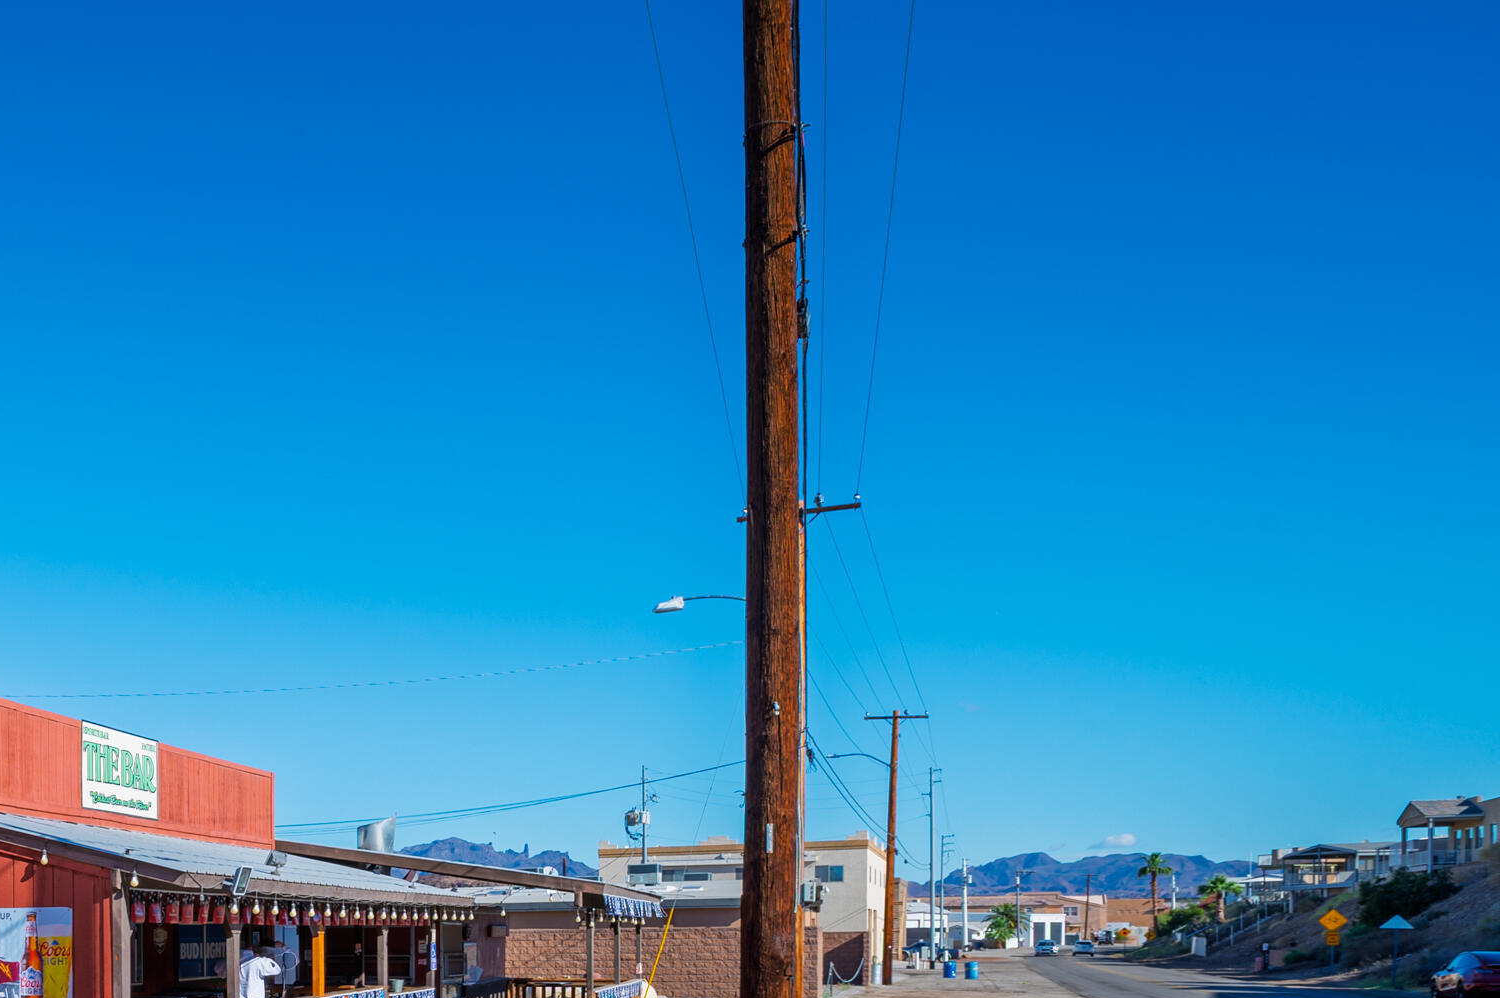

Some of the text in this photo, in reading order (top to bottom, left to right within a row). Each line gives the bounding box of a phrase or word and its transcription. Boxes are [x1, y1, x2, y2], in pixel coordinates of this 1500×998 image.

[83, 741, 156, 793] THE BAR
[39, 941, 71, 957] Coors
[180, 942, 200, 960] BUD
